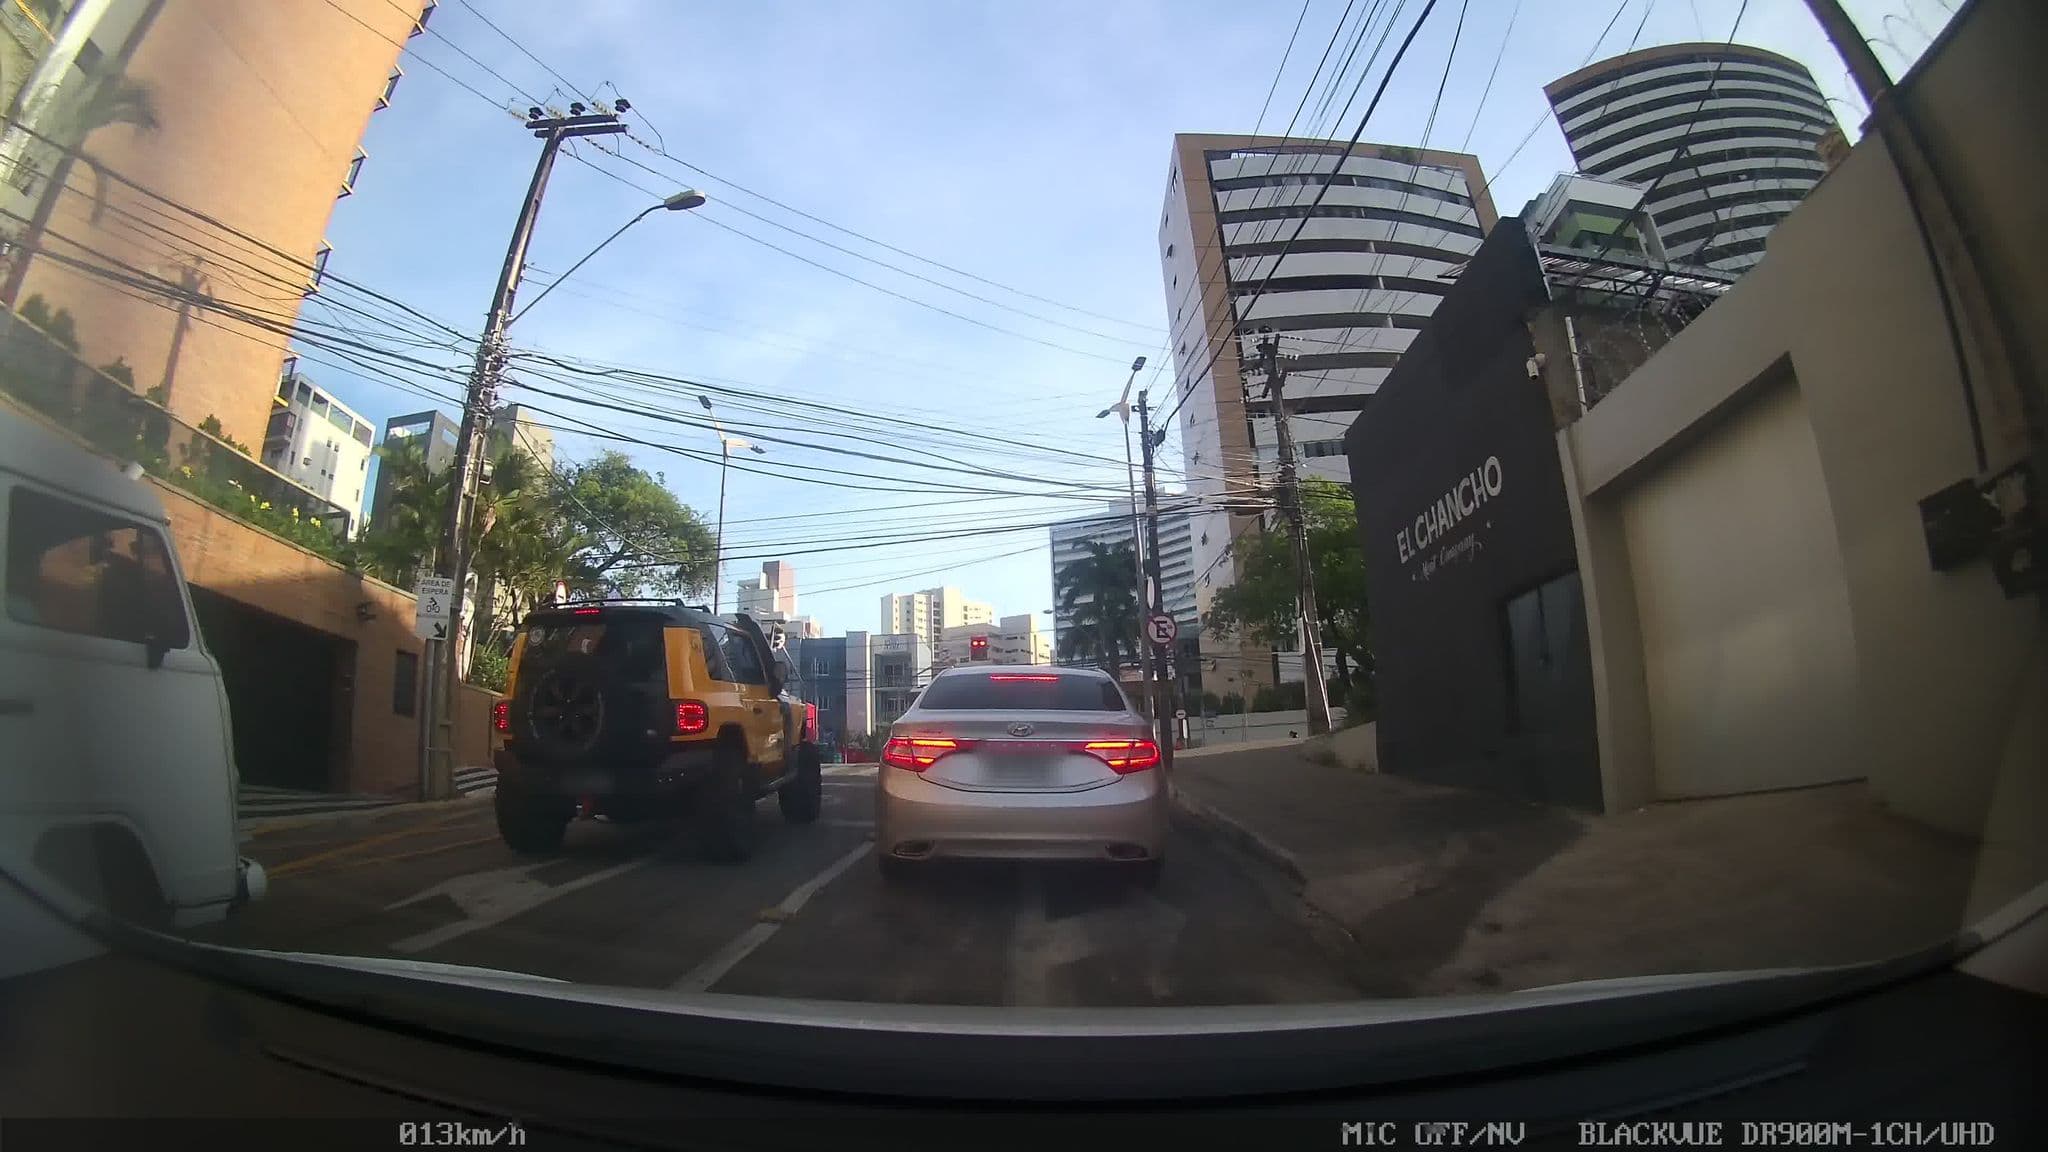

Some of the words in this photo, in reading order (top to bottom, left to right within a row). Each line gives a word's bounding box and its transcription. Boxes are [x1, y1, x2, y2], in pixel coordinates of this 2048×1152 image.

[1396, 526, 1416, 564] EL
[1414, 455, 1503, 550] CHANCHO
[441, 580, 451, 588] DE
[421, 587, 449, 595] ESPERA
